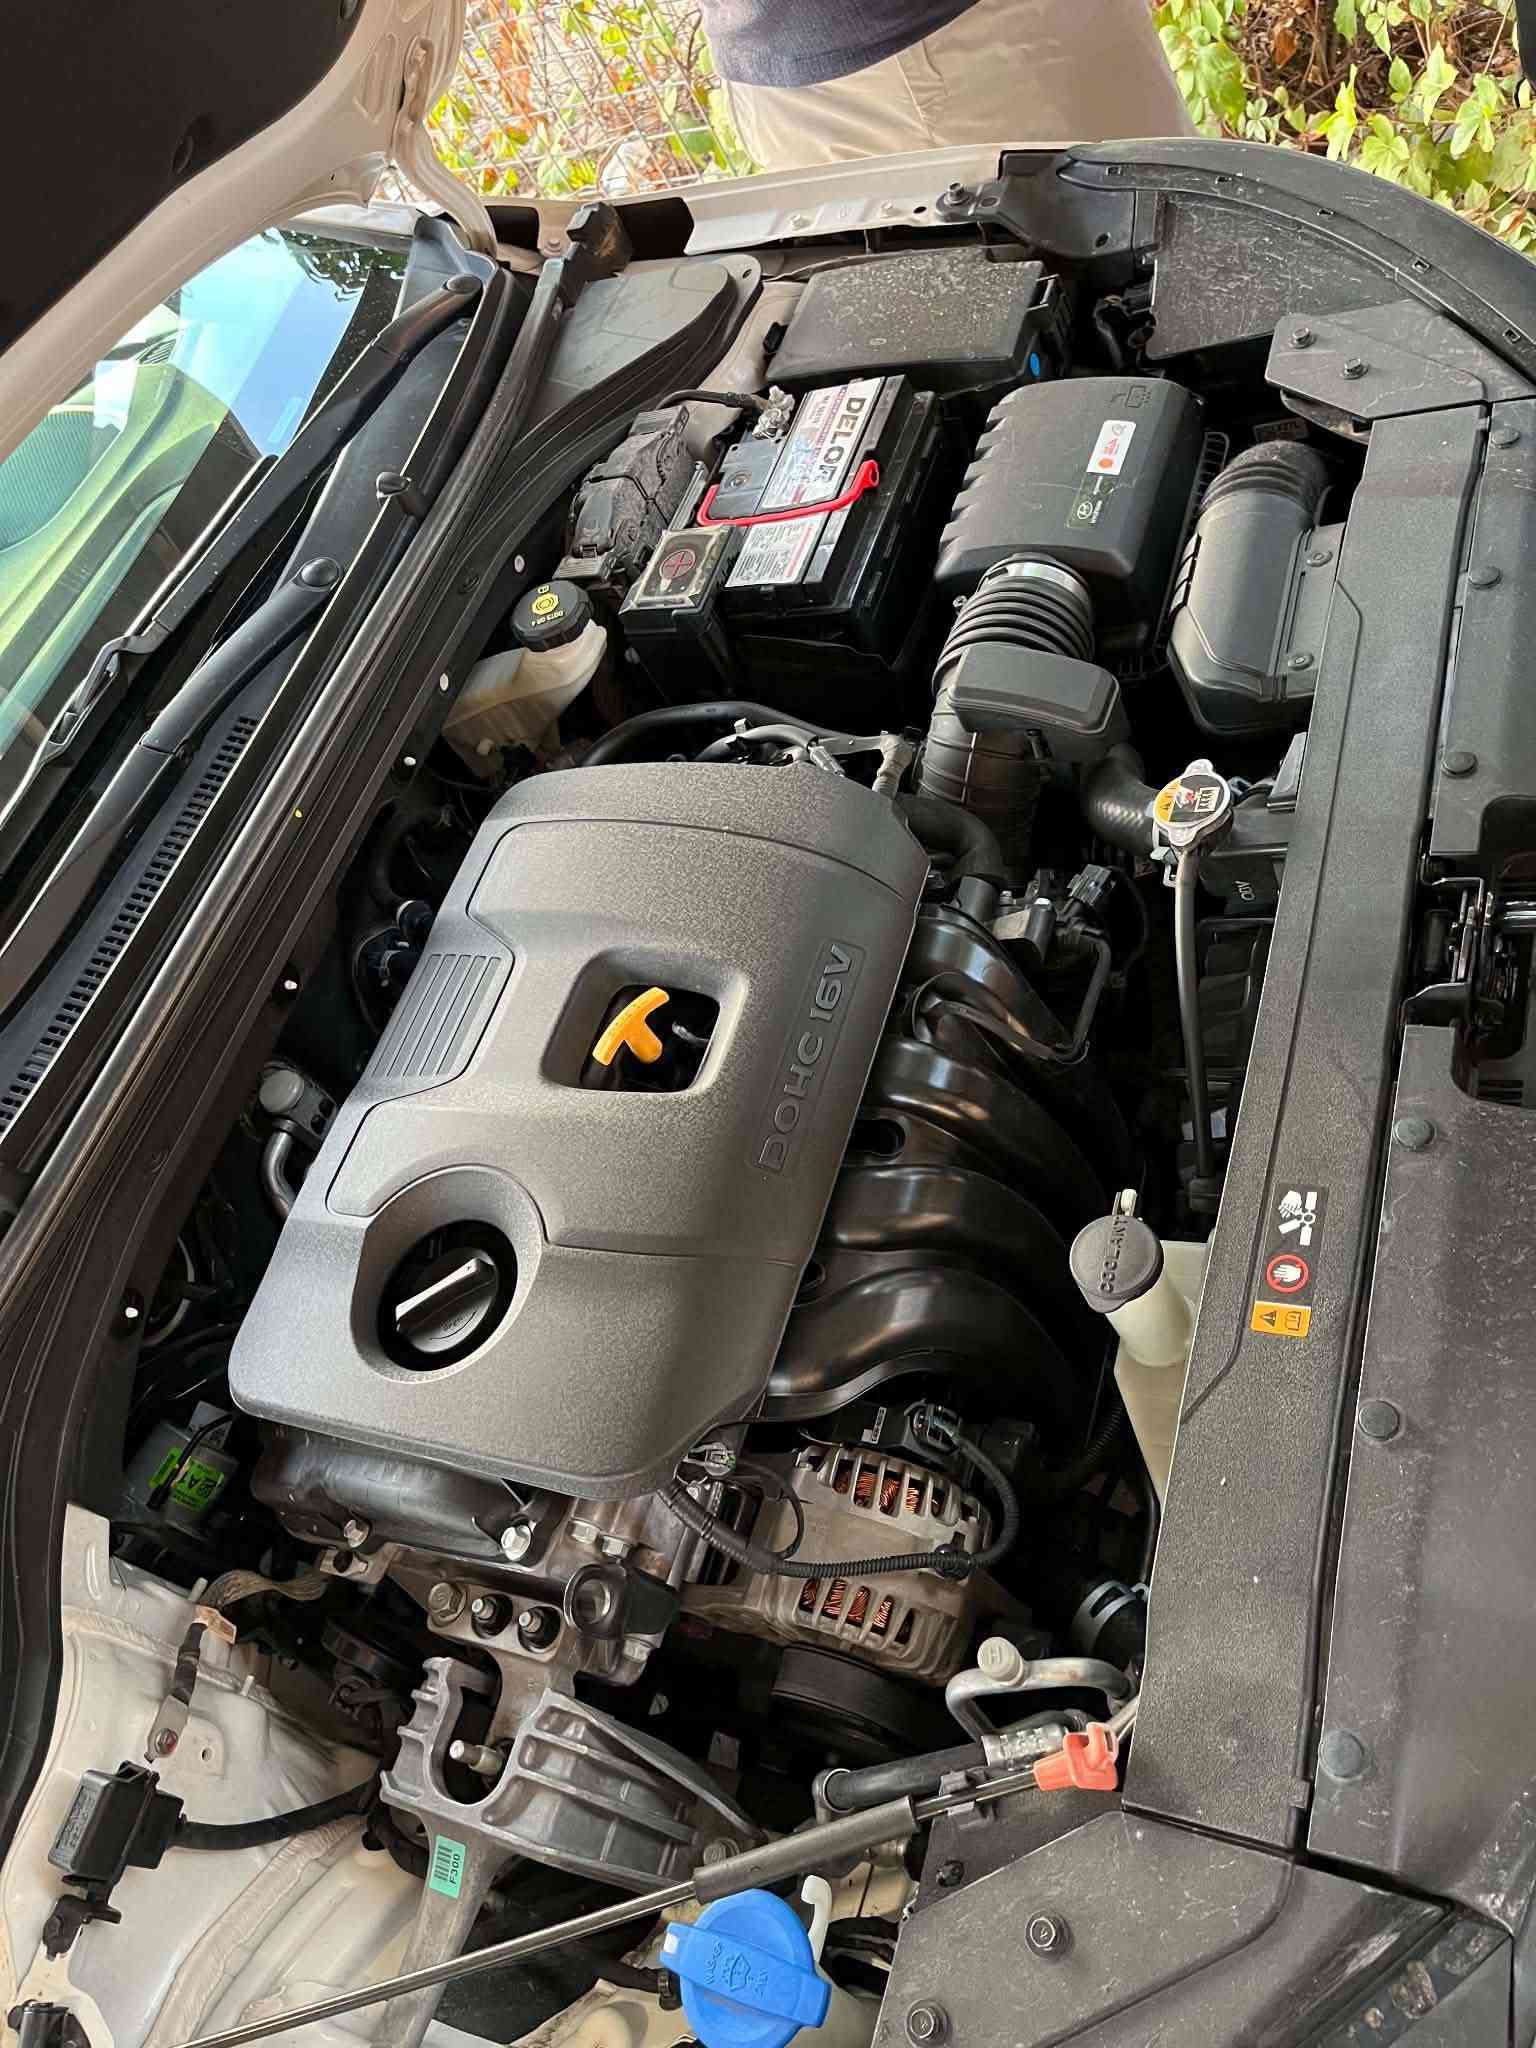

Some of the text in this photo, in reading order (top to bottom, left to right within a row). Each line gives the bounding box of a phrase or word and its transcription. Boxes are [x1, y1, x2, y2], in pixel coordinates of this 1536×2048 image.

[758, 943, 855, 1171] DOHC 16V
[1099, 1215, 1128, 1295] COOLANT
[448, 1852, 461, 1887] F300
